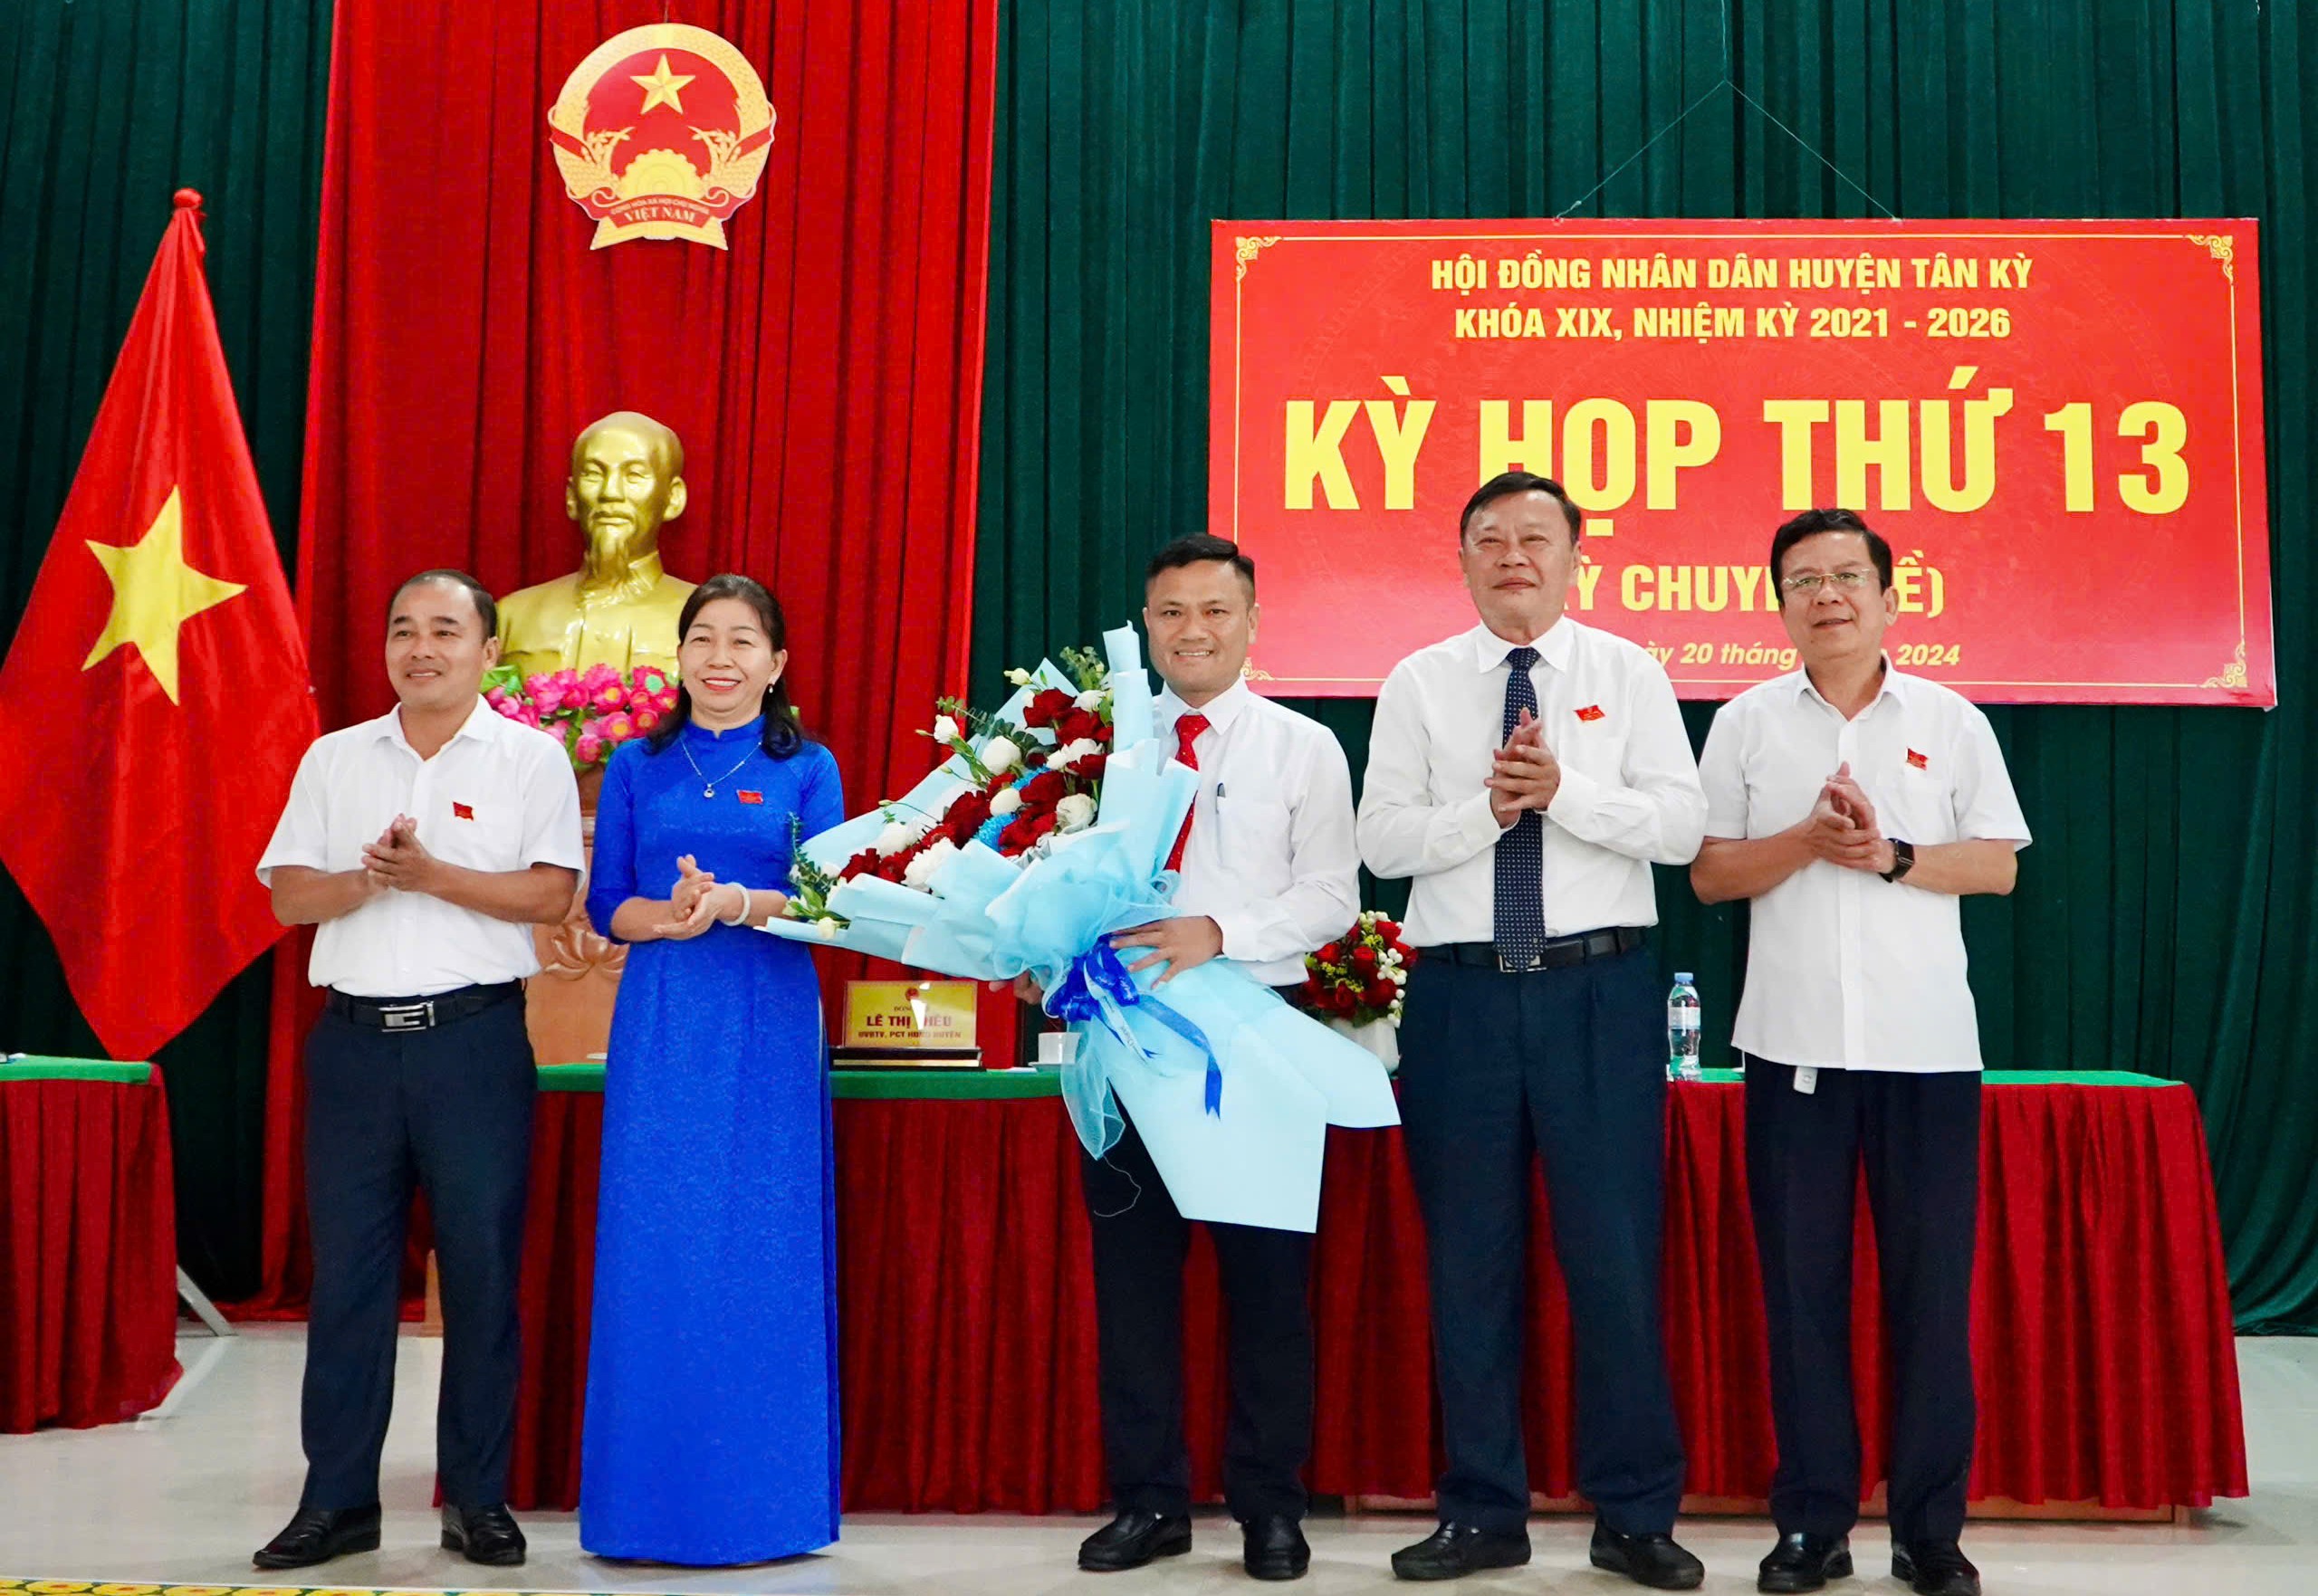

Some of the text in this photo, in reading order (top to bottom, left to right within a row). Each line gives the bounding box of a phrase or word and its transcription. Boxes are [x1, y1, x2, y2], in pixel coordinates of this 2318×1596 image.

[663, 206, 695, 223] NAM
[1432, 249, 2033, 295] HỘI ĐỒNG NHÂN DÂN HUYỆN TÂN KỲ
[1455, 301, 1546, 338] KHÓA
[1556, 308, 1623, 341] XIX,
[1633, 301, 1745, 343] NHIỆM
[1757, 301, 1799, 338] KỲ
[1810, 308, 1888, 338] 2021
[1927, 308, 2011, 338] 2026
[1285, 366, 2189, 536] KỲ HỌP THỨ 13
[1621, 564, 1779, 611] CHUY
[1893, 550, 1944, 618] Ề)
[1680, 643, 1714, 664] 20
[1720, 641, 1797, 671] tháng
[1895, 644, 1960, 665] 2024
